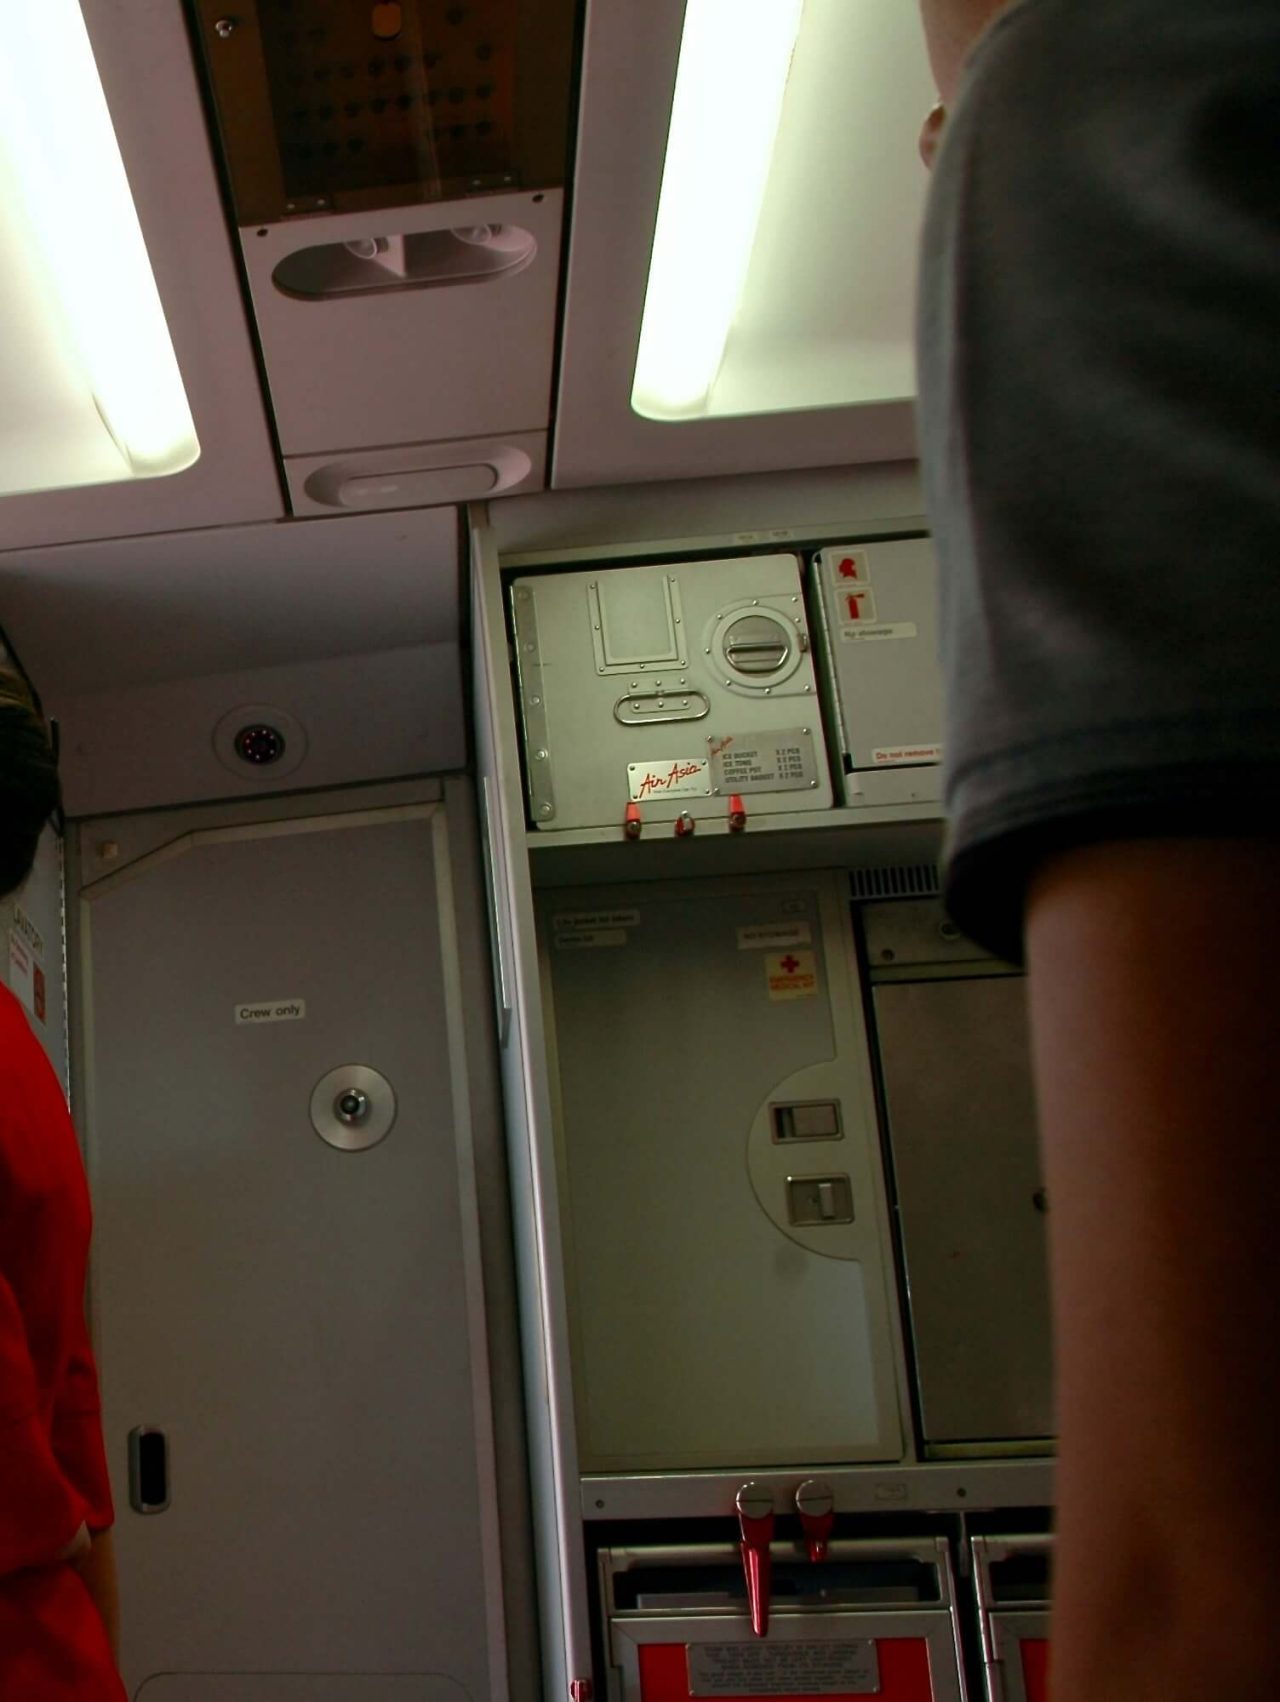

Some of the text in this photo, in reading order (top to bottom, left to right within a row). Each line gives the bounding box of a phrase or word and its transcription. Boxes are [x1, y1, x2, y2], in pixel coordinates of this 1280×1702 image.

[639, 762, 701, 798] Air Asia
[240, 1004, 300, 1019] Crew only
